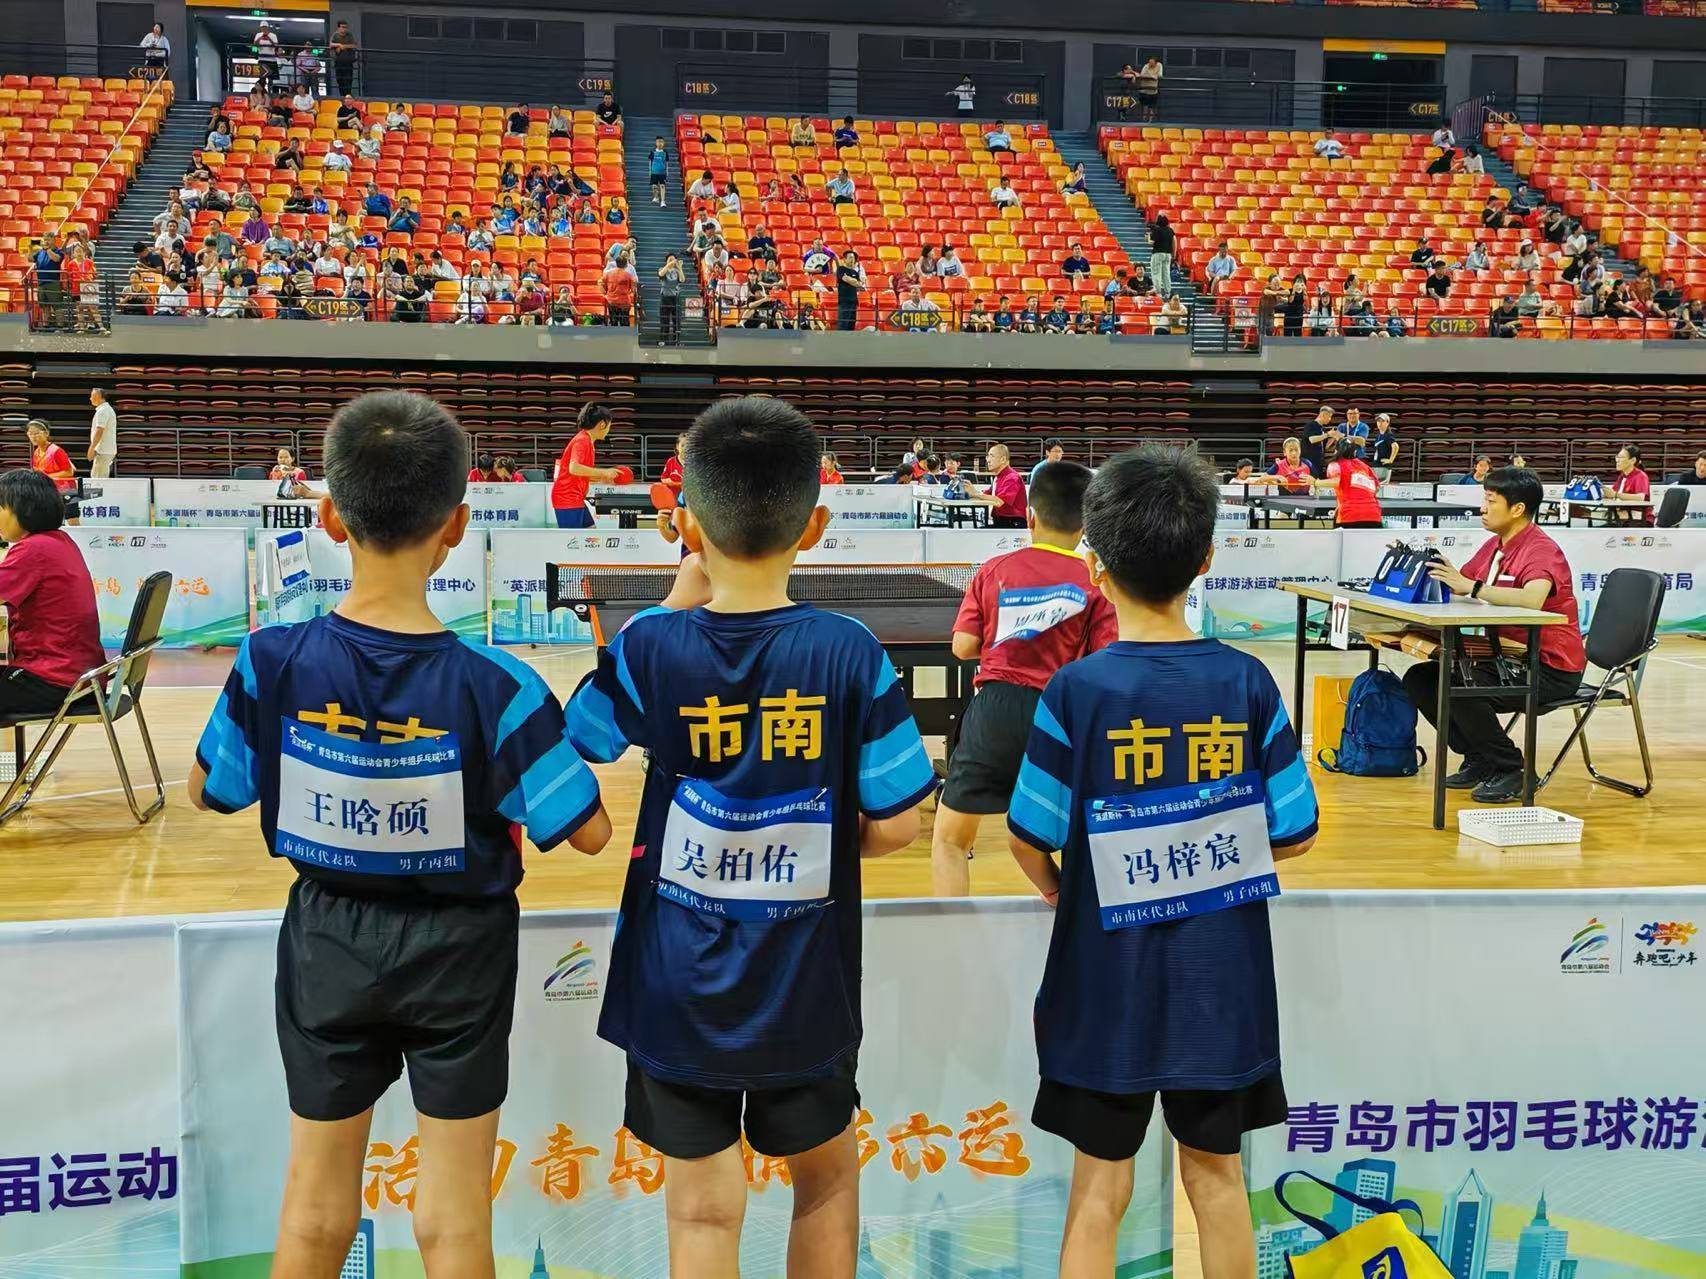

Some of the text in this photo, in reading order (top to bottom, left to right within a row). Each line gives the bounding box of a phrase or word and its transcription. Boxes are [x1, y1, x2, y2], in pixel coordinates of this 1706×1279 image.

[78, 505, 121, 518] 体育局
[472, 509, 519, 521] 市体育局
[309, 578, 353, 593] 羽毛球
[679, 688, 826, 763] 市南
[1107, 715, 1248, 785] 市南
[304, 788, 429, 837] 王晗硕
[284, 839, 457, 871] 市南区代表队 男子丙组
[676, 837, 799, 884] 吴柏佑
[1123, 833, 1240, 885] 冯梓宸
[1111, 880, 1273, 925] 市南区代表队 男子丙组
[1284, 1096, 1706, 1154] 青岛市羽毛球游
